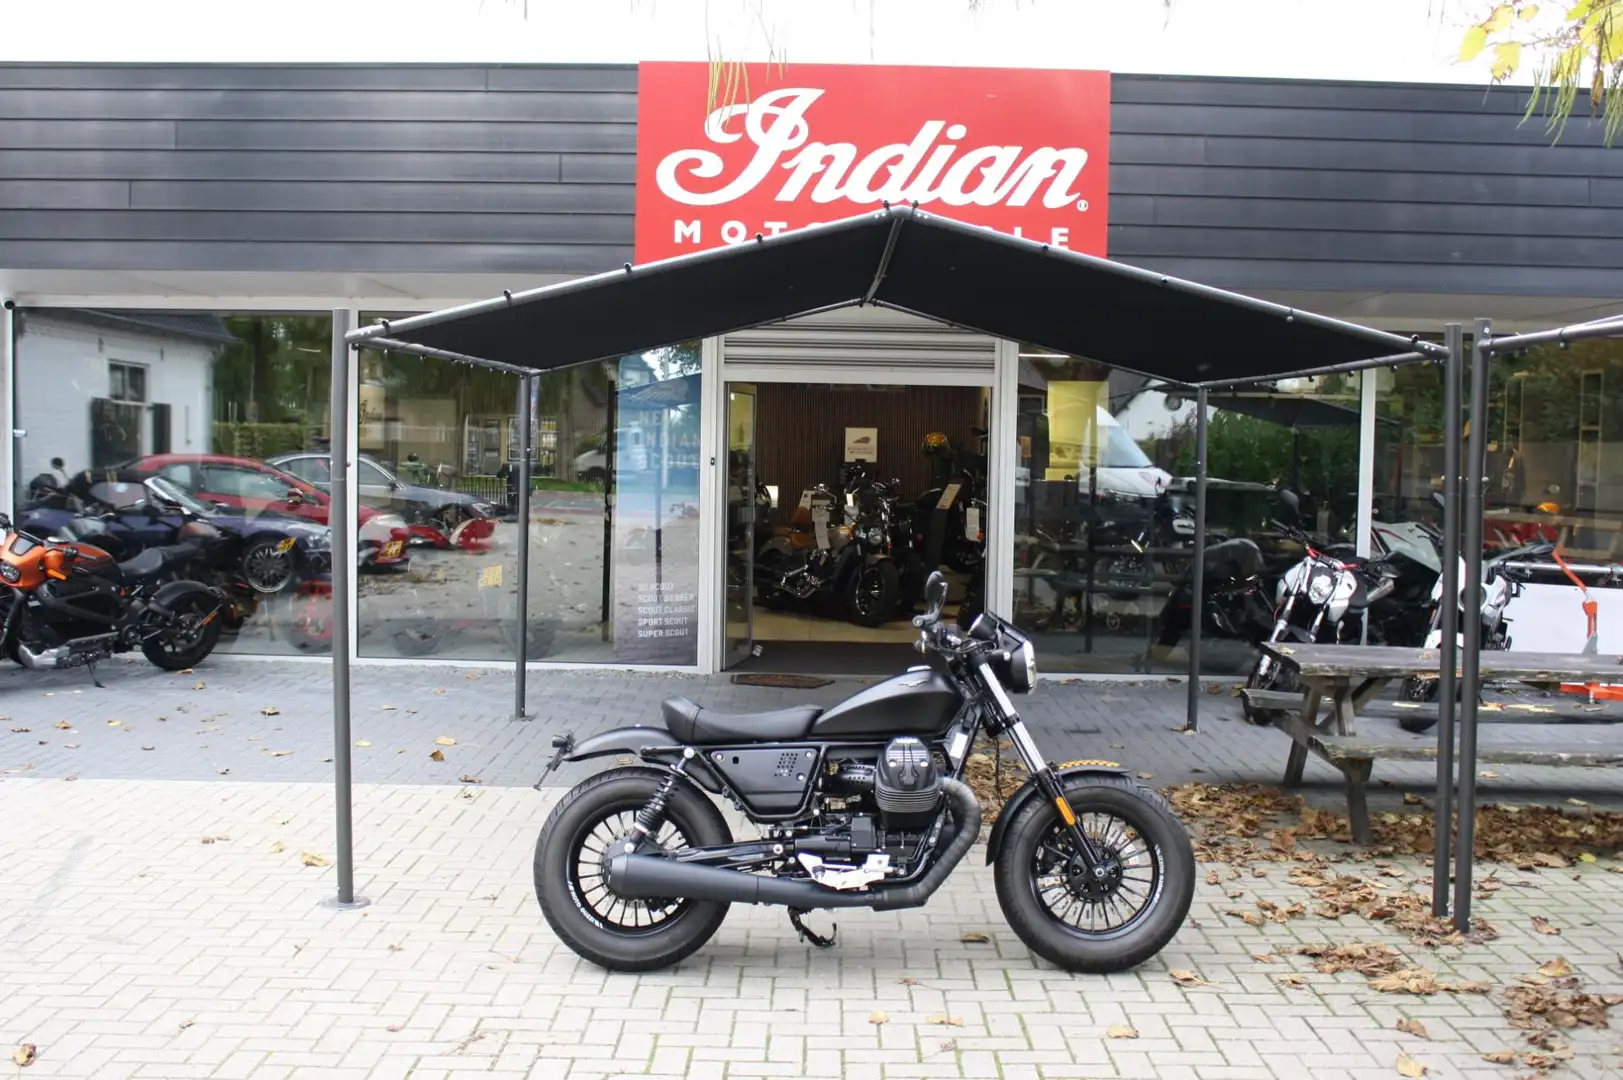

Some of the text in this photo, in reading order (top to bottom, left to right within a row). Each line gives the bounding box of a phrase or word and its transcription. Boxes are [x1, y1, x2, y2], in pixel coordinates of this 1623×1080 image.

[655, 87, 1088, 209] Indian
[638, 606, 662, 614] SCOUT
[638, 617, 688, 626] SPORT SCOUT
[638, 628, 689, 638] SUPER SCOUT
